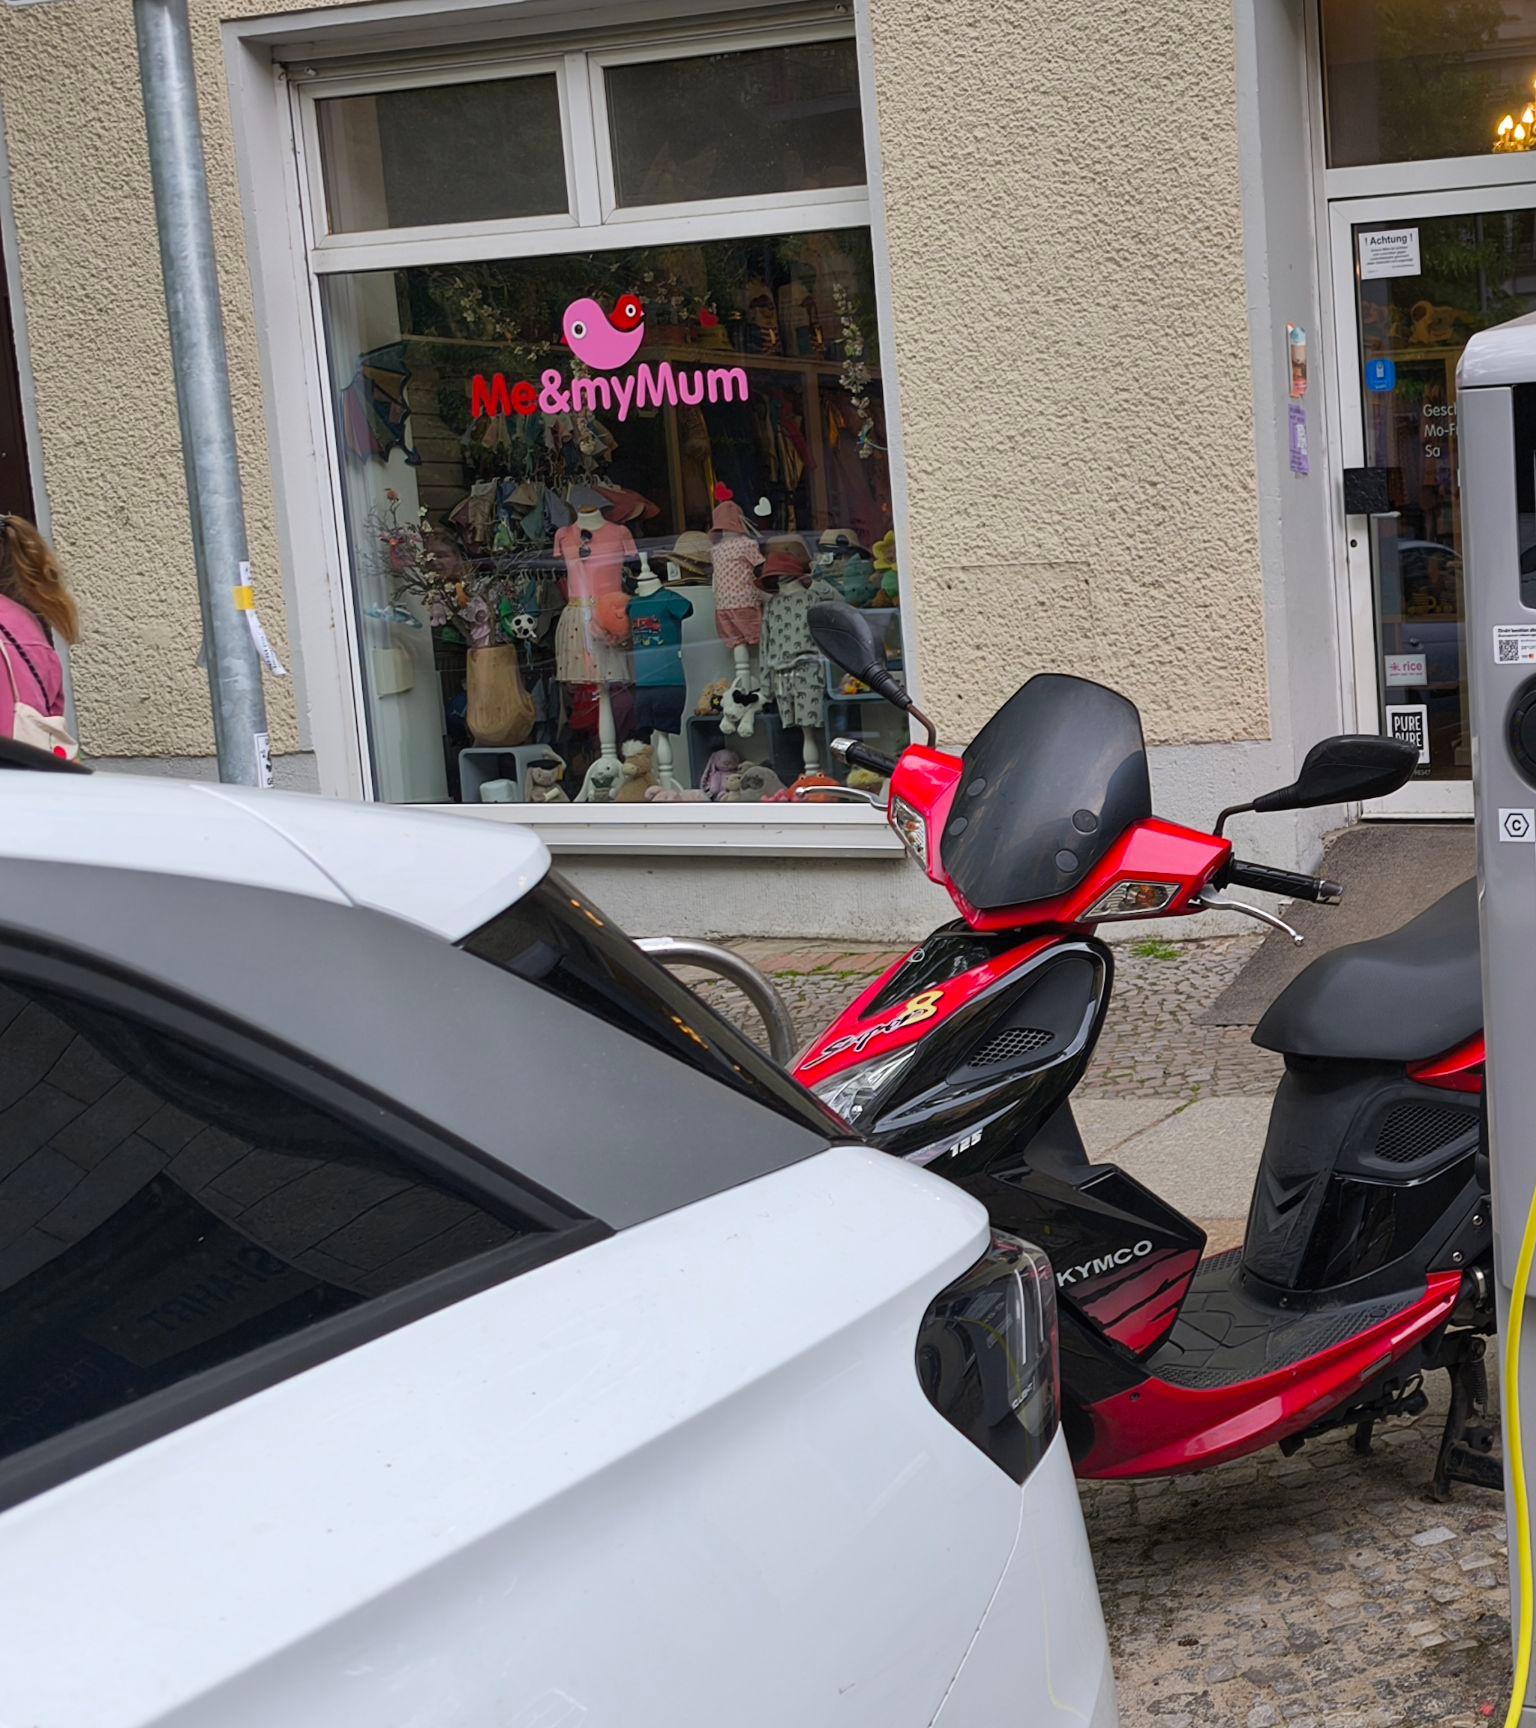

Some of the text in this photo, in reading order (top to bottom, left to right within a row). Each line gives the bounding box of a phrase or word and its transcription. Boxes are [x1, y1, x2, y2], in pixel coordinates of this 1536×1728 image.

[1370, 234, 1408, 246] Achtung
[472, 361, 749, 422] Me&myMum
[1425, 445, 1441, 458] Sa
[1402, 661, 1423, 671] rice
[1394, 715, 1421, 732] PURE
[1512, 820, 1521, 831] C
[950, 1127, 984, 1158] 125
[1056, 1240, 1153, 1287] KYMCO
